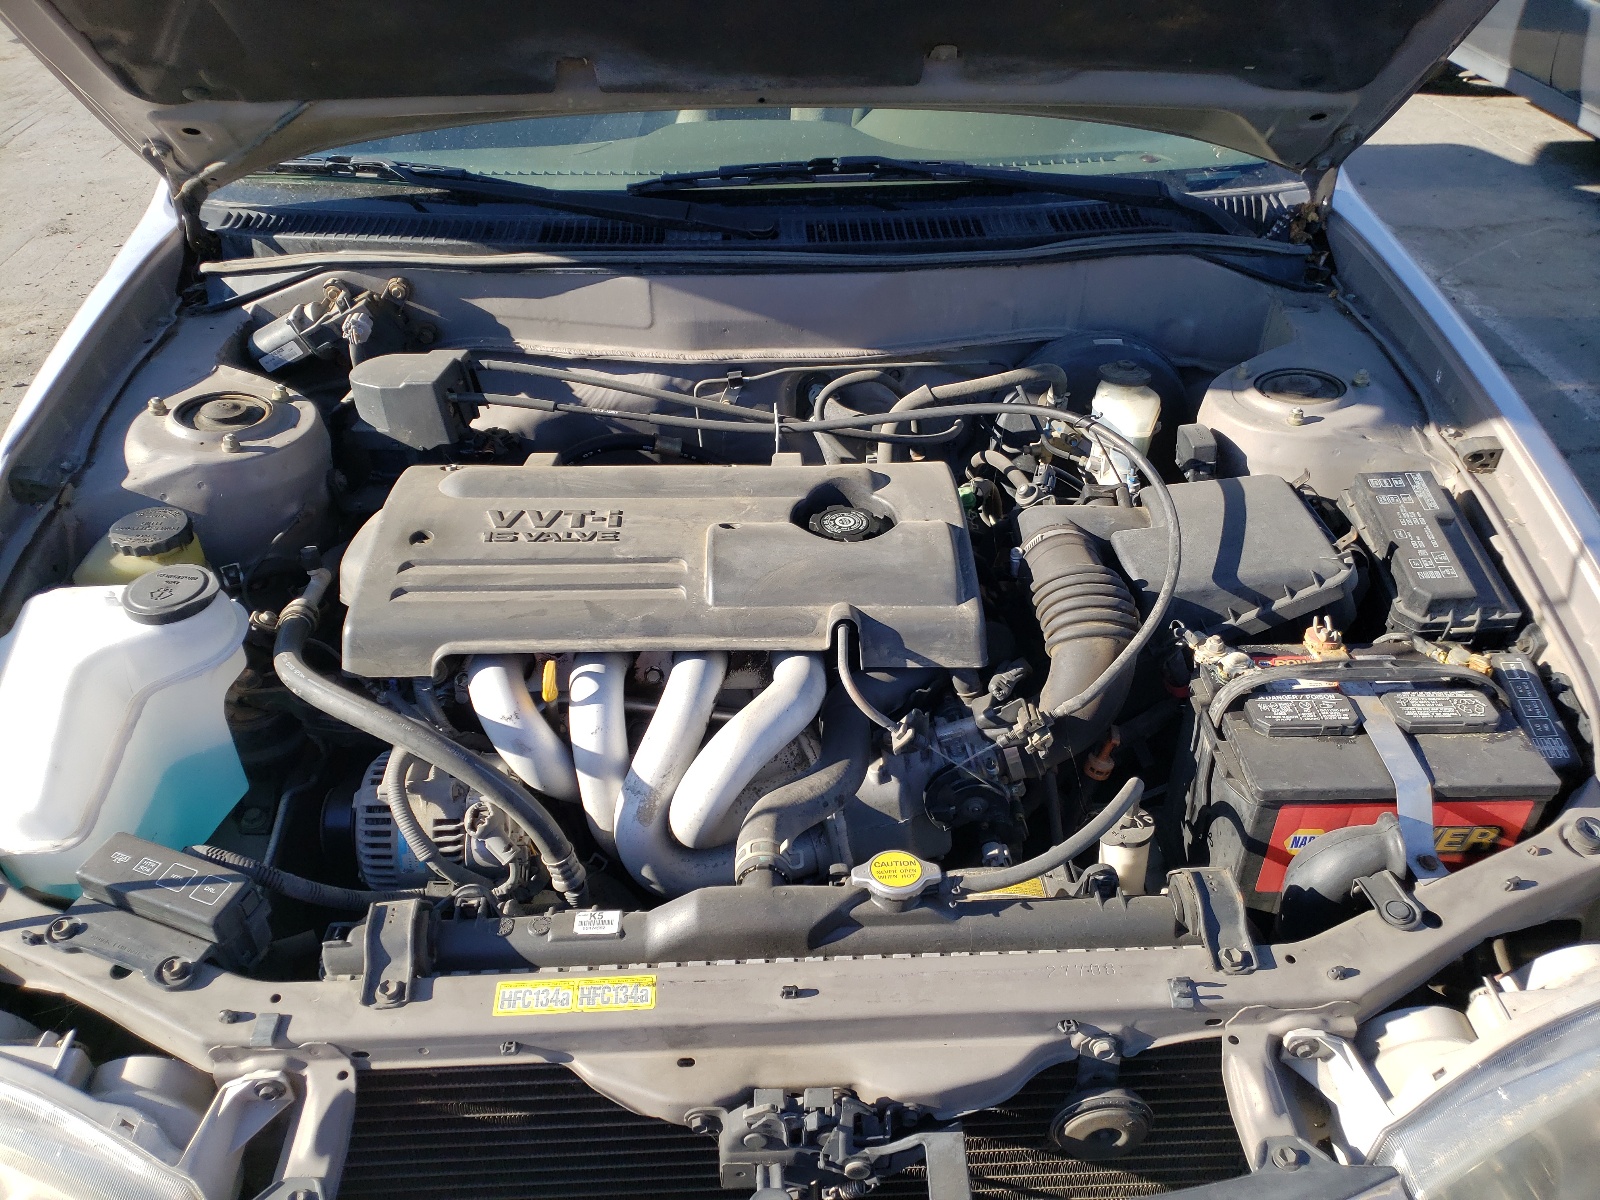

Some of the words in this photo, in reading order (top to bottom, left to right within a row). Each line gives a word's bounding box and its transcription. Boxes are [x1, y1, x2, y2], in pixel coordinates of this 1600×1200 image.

[521, 531, 620, 543] VALVE
[873, 860, 917, 868] CAUTION
[500, 988, 571, 1009] HFC134a
[578, 985, 649, 1006] HFC134a
